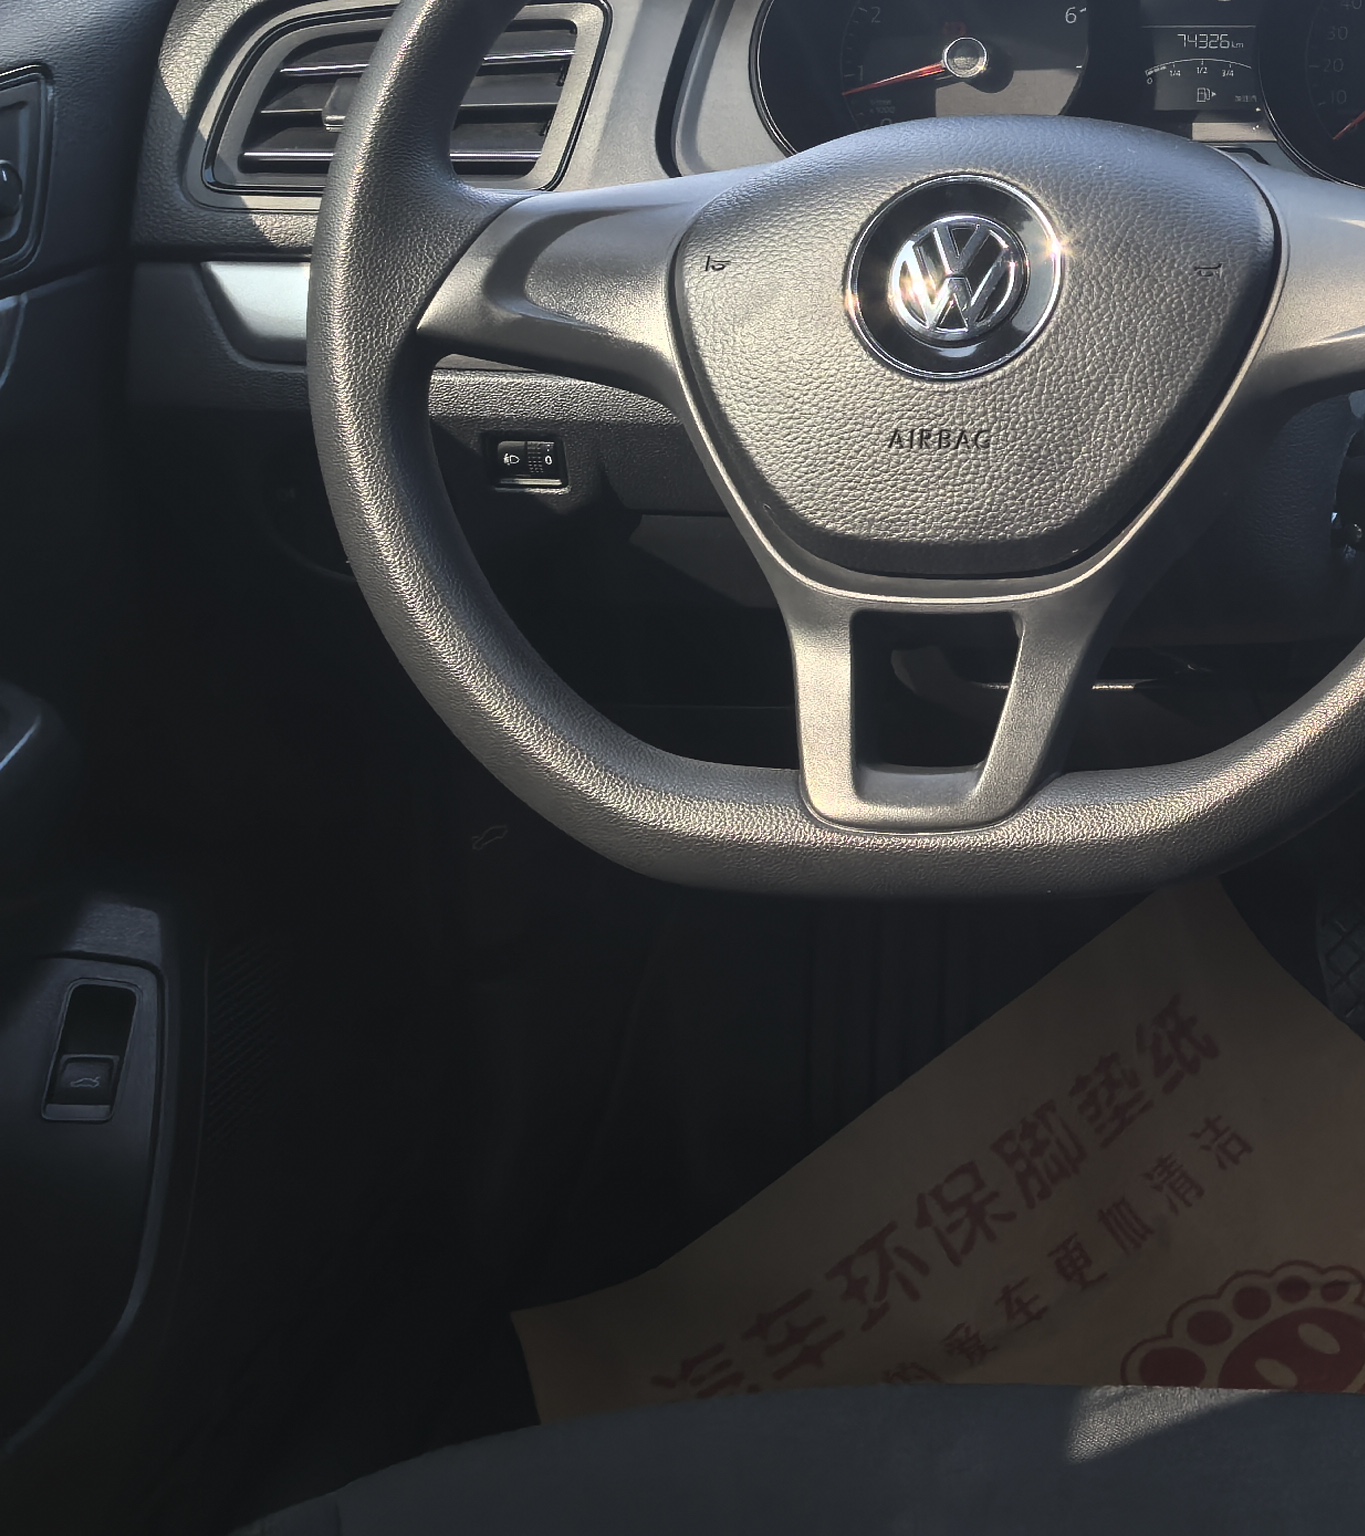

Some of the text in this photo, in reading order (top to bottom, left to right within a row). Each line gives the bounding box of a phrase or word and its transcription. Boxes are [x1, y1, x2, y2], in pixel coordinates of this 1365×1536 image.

[870, 7, 881, 24] 2
[1065, 6, 1077, 24] 6
[1323, 58, 1344, 72] 20
[1331, 90, 1347, 105] 10
[887, 428, 992, 451] AIRBAG
